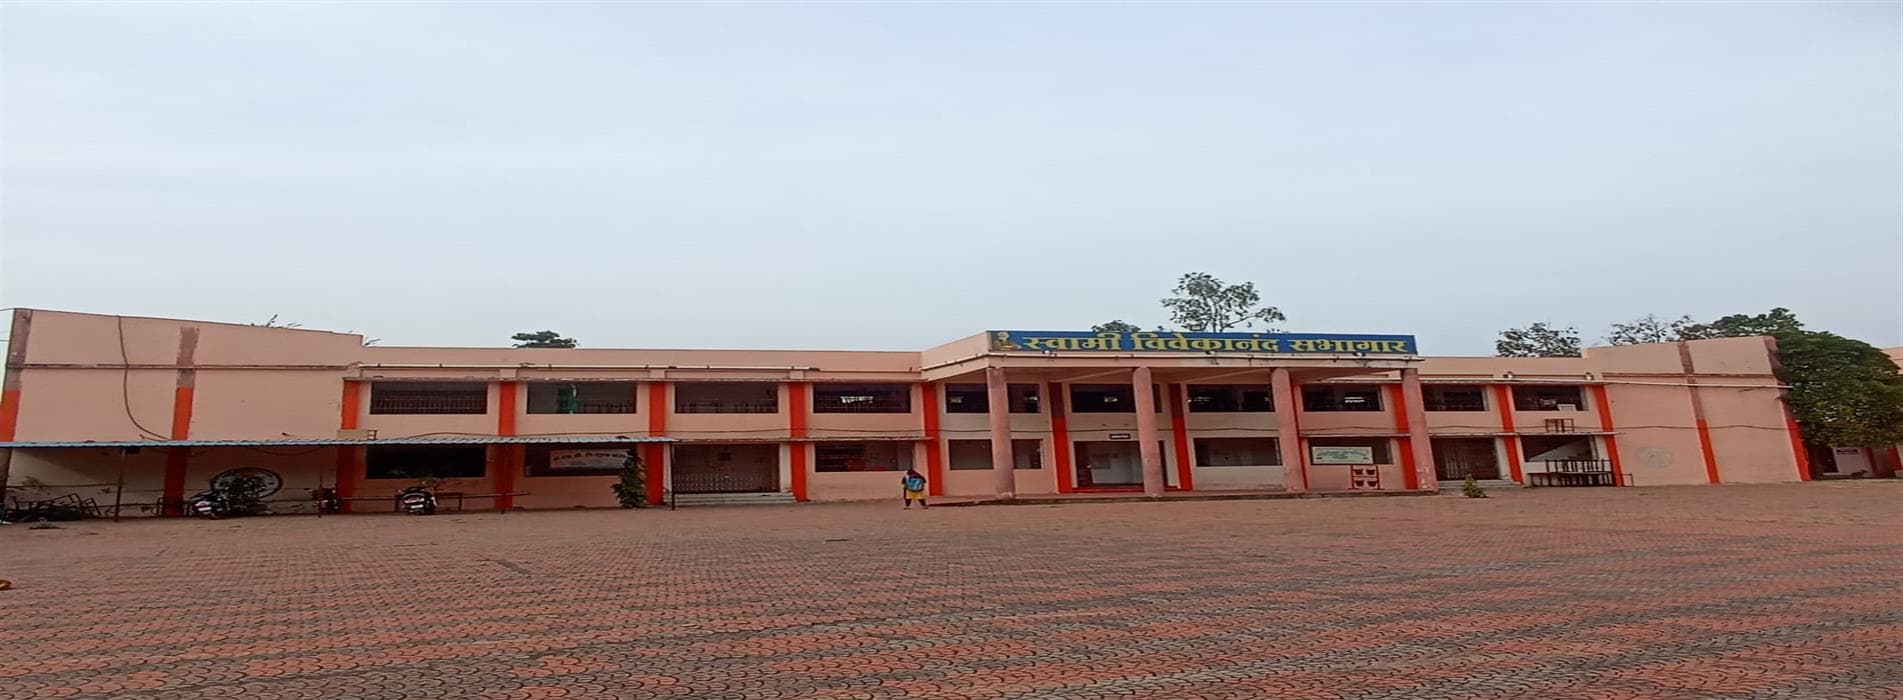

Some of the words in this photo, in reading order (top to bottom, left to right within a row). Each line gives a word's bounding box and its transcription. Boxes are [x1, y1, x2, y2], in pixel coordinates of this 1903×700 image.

[1022, 332, 1121, 350] स्वामी
[1130, 332, 1279, 351] विवेकानंद
[1287, 338, 1409, 352] सभागार
